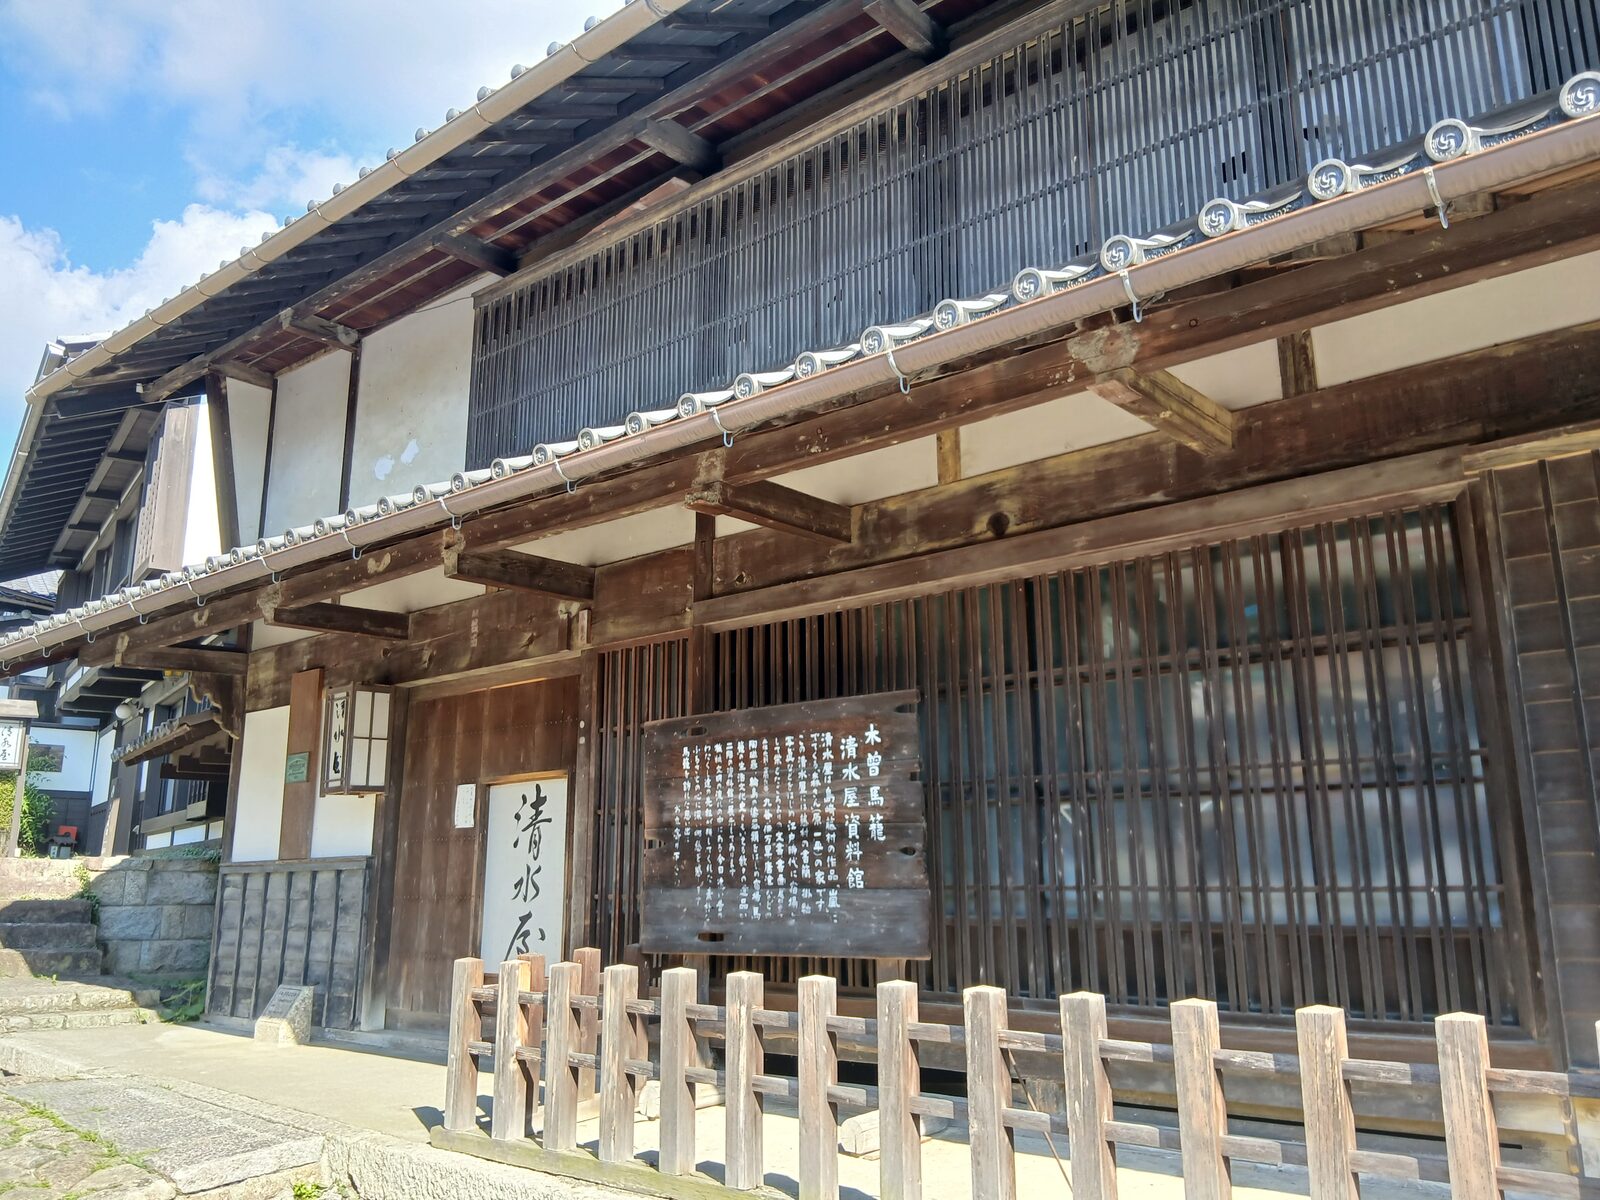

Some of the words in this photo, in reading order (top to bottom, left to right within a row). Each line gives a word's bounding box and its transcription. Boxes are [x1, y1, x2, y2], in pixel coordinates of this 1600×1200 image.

[840, 736, 864, 889] 清水屋資料館
